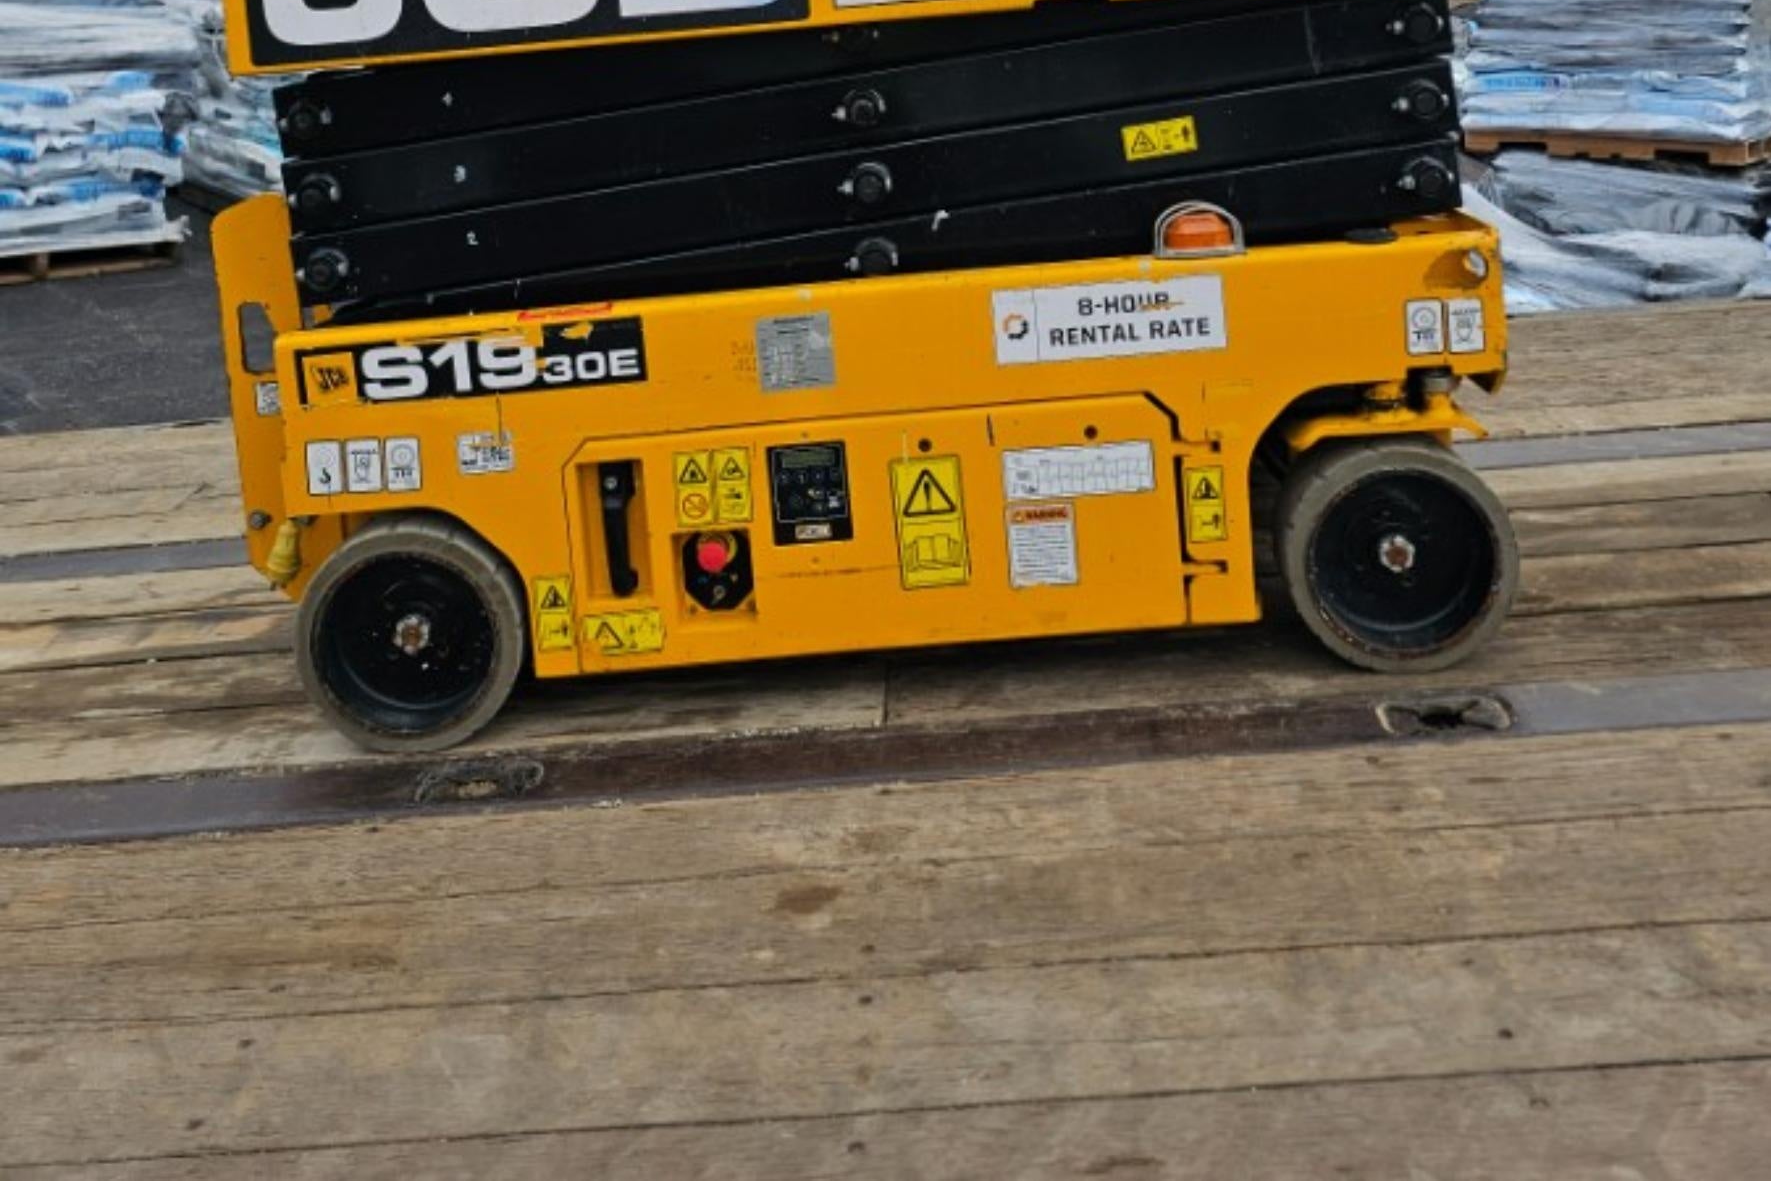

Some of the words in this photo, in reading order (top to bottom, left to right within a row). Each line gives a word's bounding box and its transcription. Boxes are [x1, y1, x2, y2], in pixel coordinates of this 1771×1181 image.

[1077, 291, 1171, 317] 8-HOUR
[1049, 322, 1141, 348] RENTAL
[1149, 316, 1211, 340] RATE
[360, 337, 540, 401] S19
[541, 347, 643, 385] 30E
